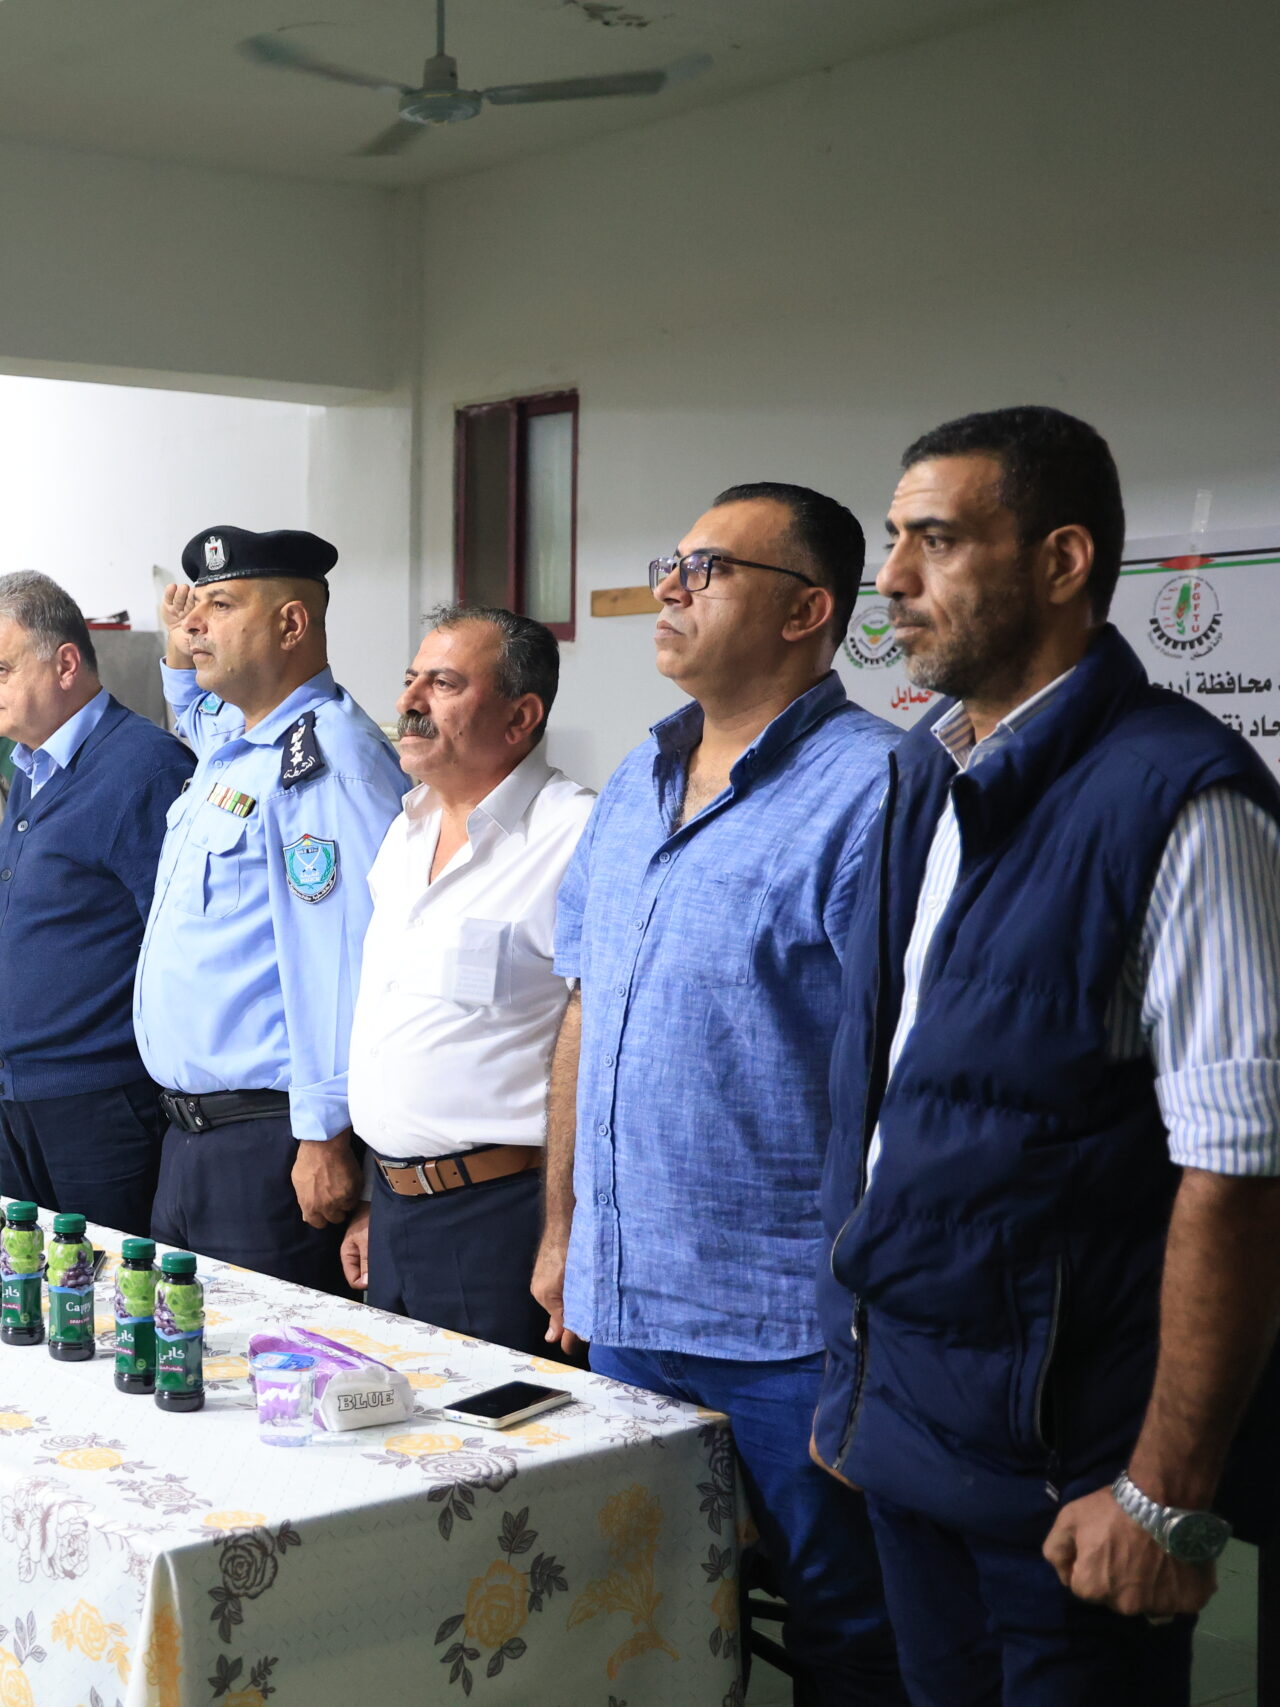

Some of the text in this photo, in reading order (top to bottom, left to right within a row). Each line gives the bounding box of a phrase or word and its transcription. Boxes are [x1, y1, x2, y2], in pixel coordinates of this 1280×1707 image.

[1192, 582, 1201, 633] PGFTU
[1197, 671, 1272, 694] محافظة
[283, 755, 315, 778] الشرطة
[65, 1301, 91, 1314] Cappy
[159, 1346, 185, 1364] كابي
[338, 1389, 394, 1412] BLUE
